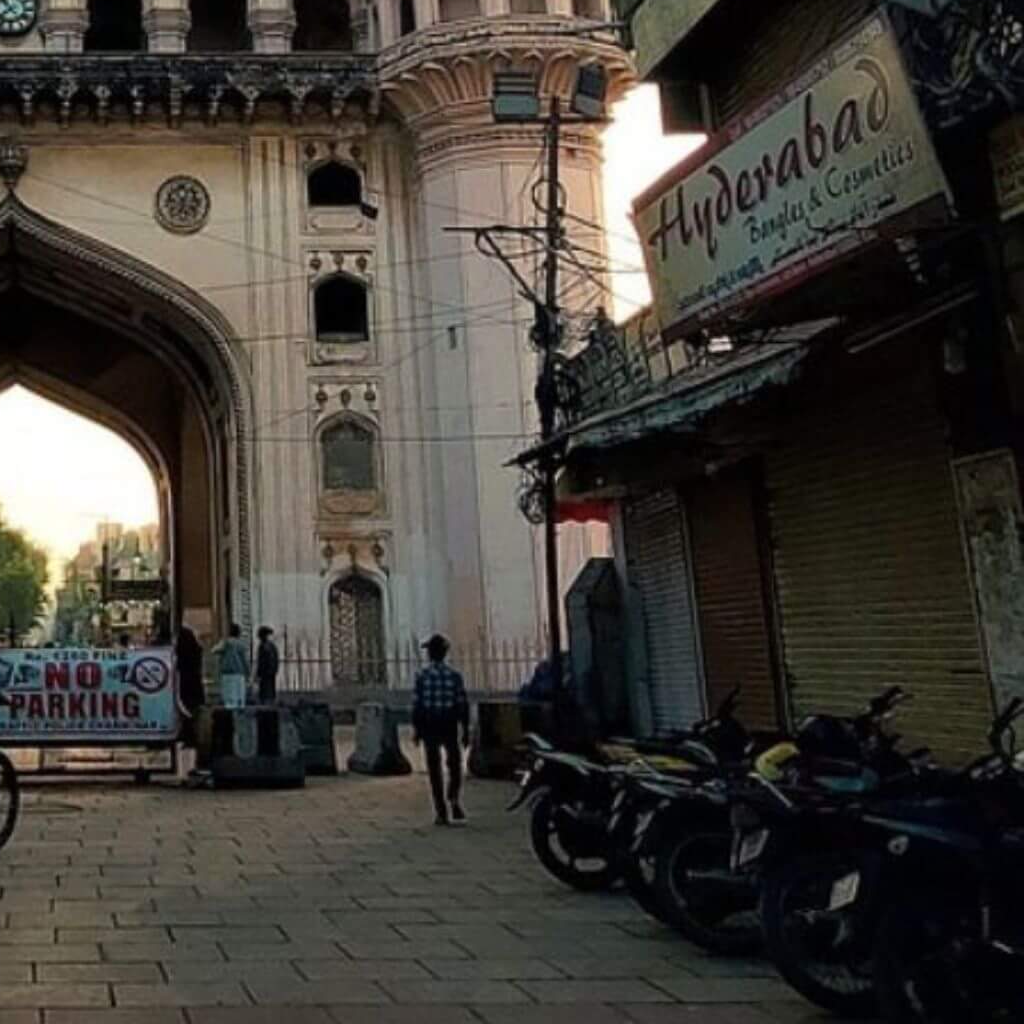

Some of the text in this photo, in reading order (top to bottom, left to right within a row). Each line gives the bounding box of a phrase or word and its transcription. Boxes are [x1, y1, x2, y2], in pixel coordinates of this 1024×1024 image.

[648, 58, 889, 262] Hyderabad
[743, 203, 805, 246] Bangles
[809, 186, 824, 211] &
[827, 141, 914, 199] Cosmetics
[9, 692, 141, 719] PARKING
[44, 661, 103, 690] NO
